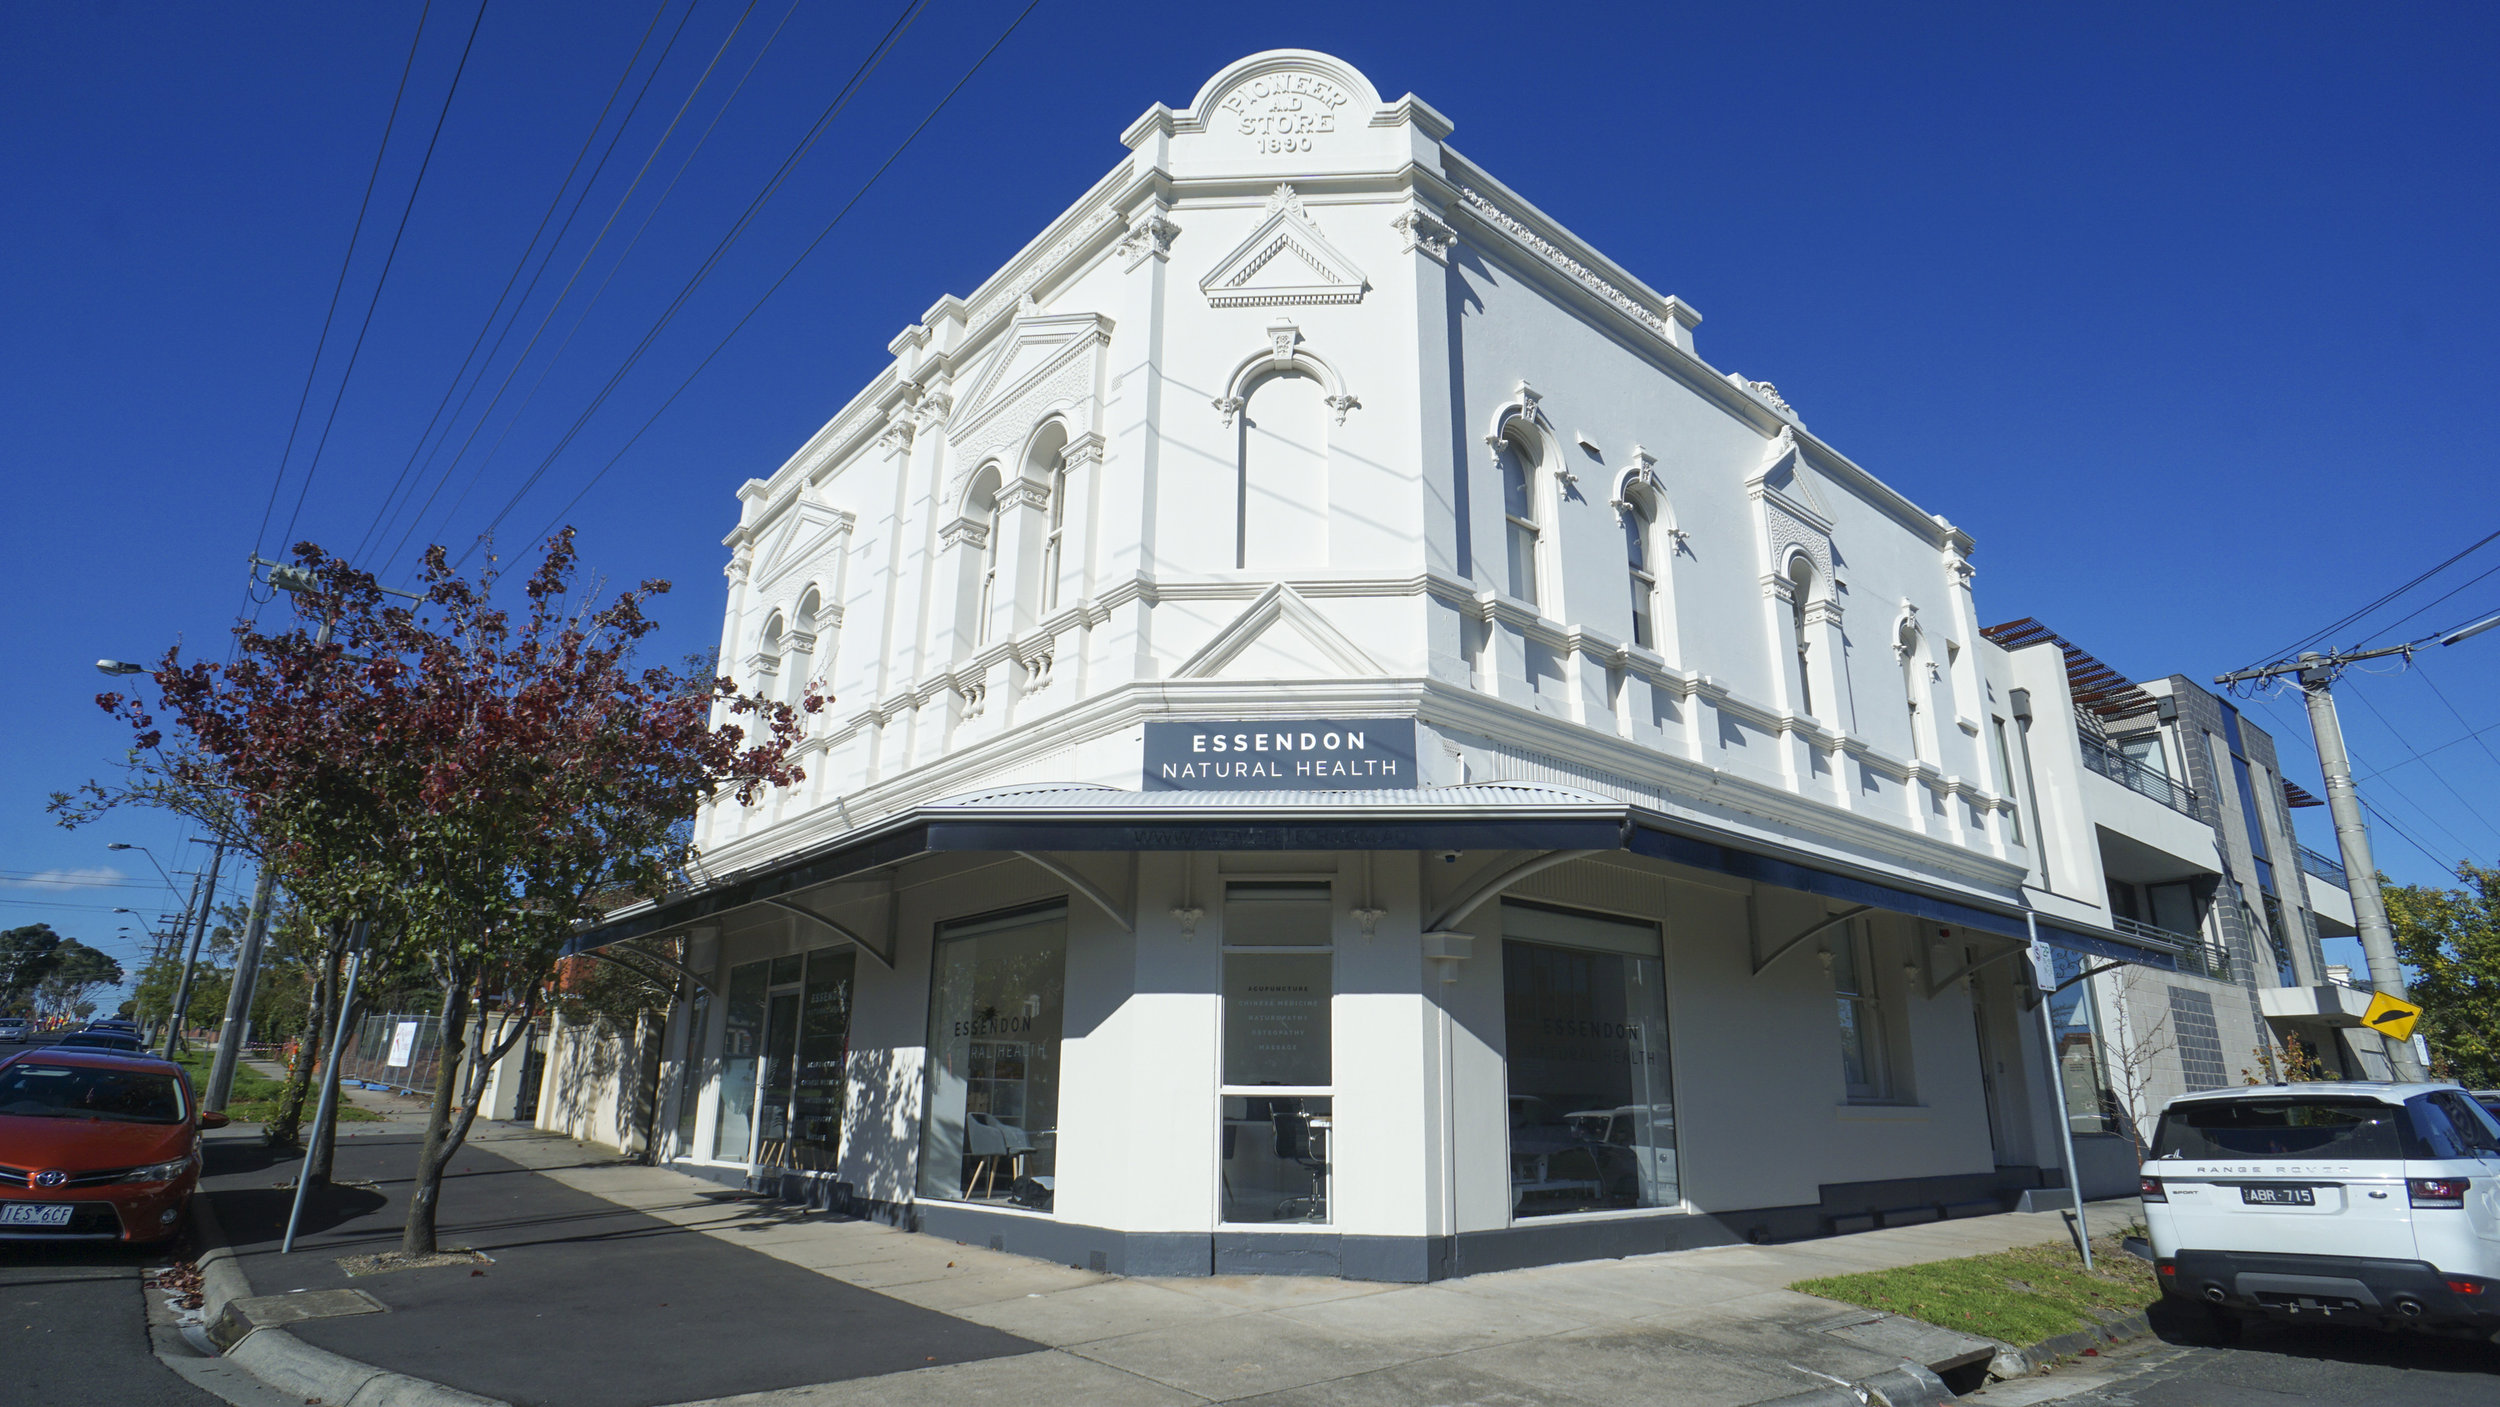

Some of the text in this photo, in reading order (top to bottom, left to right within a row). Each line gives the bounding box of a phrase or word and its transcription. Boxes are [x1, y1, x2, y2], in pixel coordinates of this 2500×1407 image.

[1222, 74, 1348, 116] PIONEER
[1238, 114, 1335, 135] STORE
[1257, 138, 1312, 154] 1890
[1193, 732, 1365, 752] ESSENDON
[1163, 760, 1396, 779] NATURAL HEALTH
[954, 1015, 1032, 1037] ESSENDON
[1543, 1018, 1638, 1040] ESSENDON
[2276, 1166, 2350, 1174] ROVER
[41, 1208, 71, 1221] 6CF
